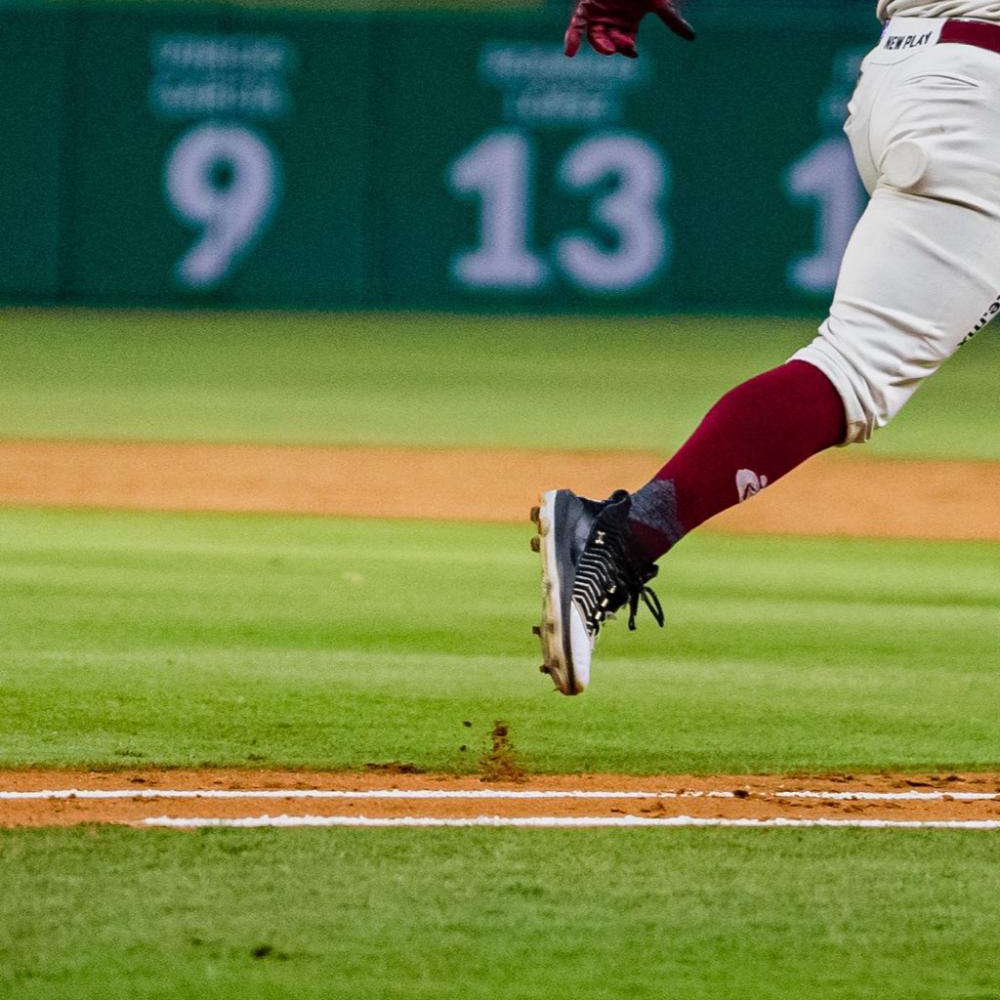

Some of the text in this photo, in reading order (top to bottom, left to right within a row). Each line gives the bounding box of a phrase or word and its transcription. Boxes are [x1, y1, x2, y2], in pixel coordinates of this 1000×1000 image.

[884, 32, 932, 50] NEW PLAY
[163, 120, 282, 288] 9
[447, 130, 668, 292] 13
